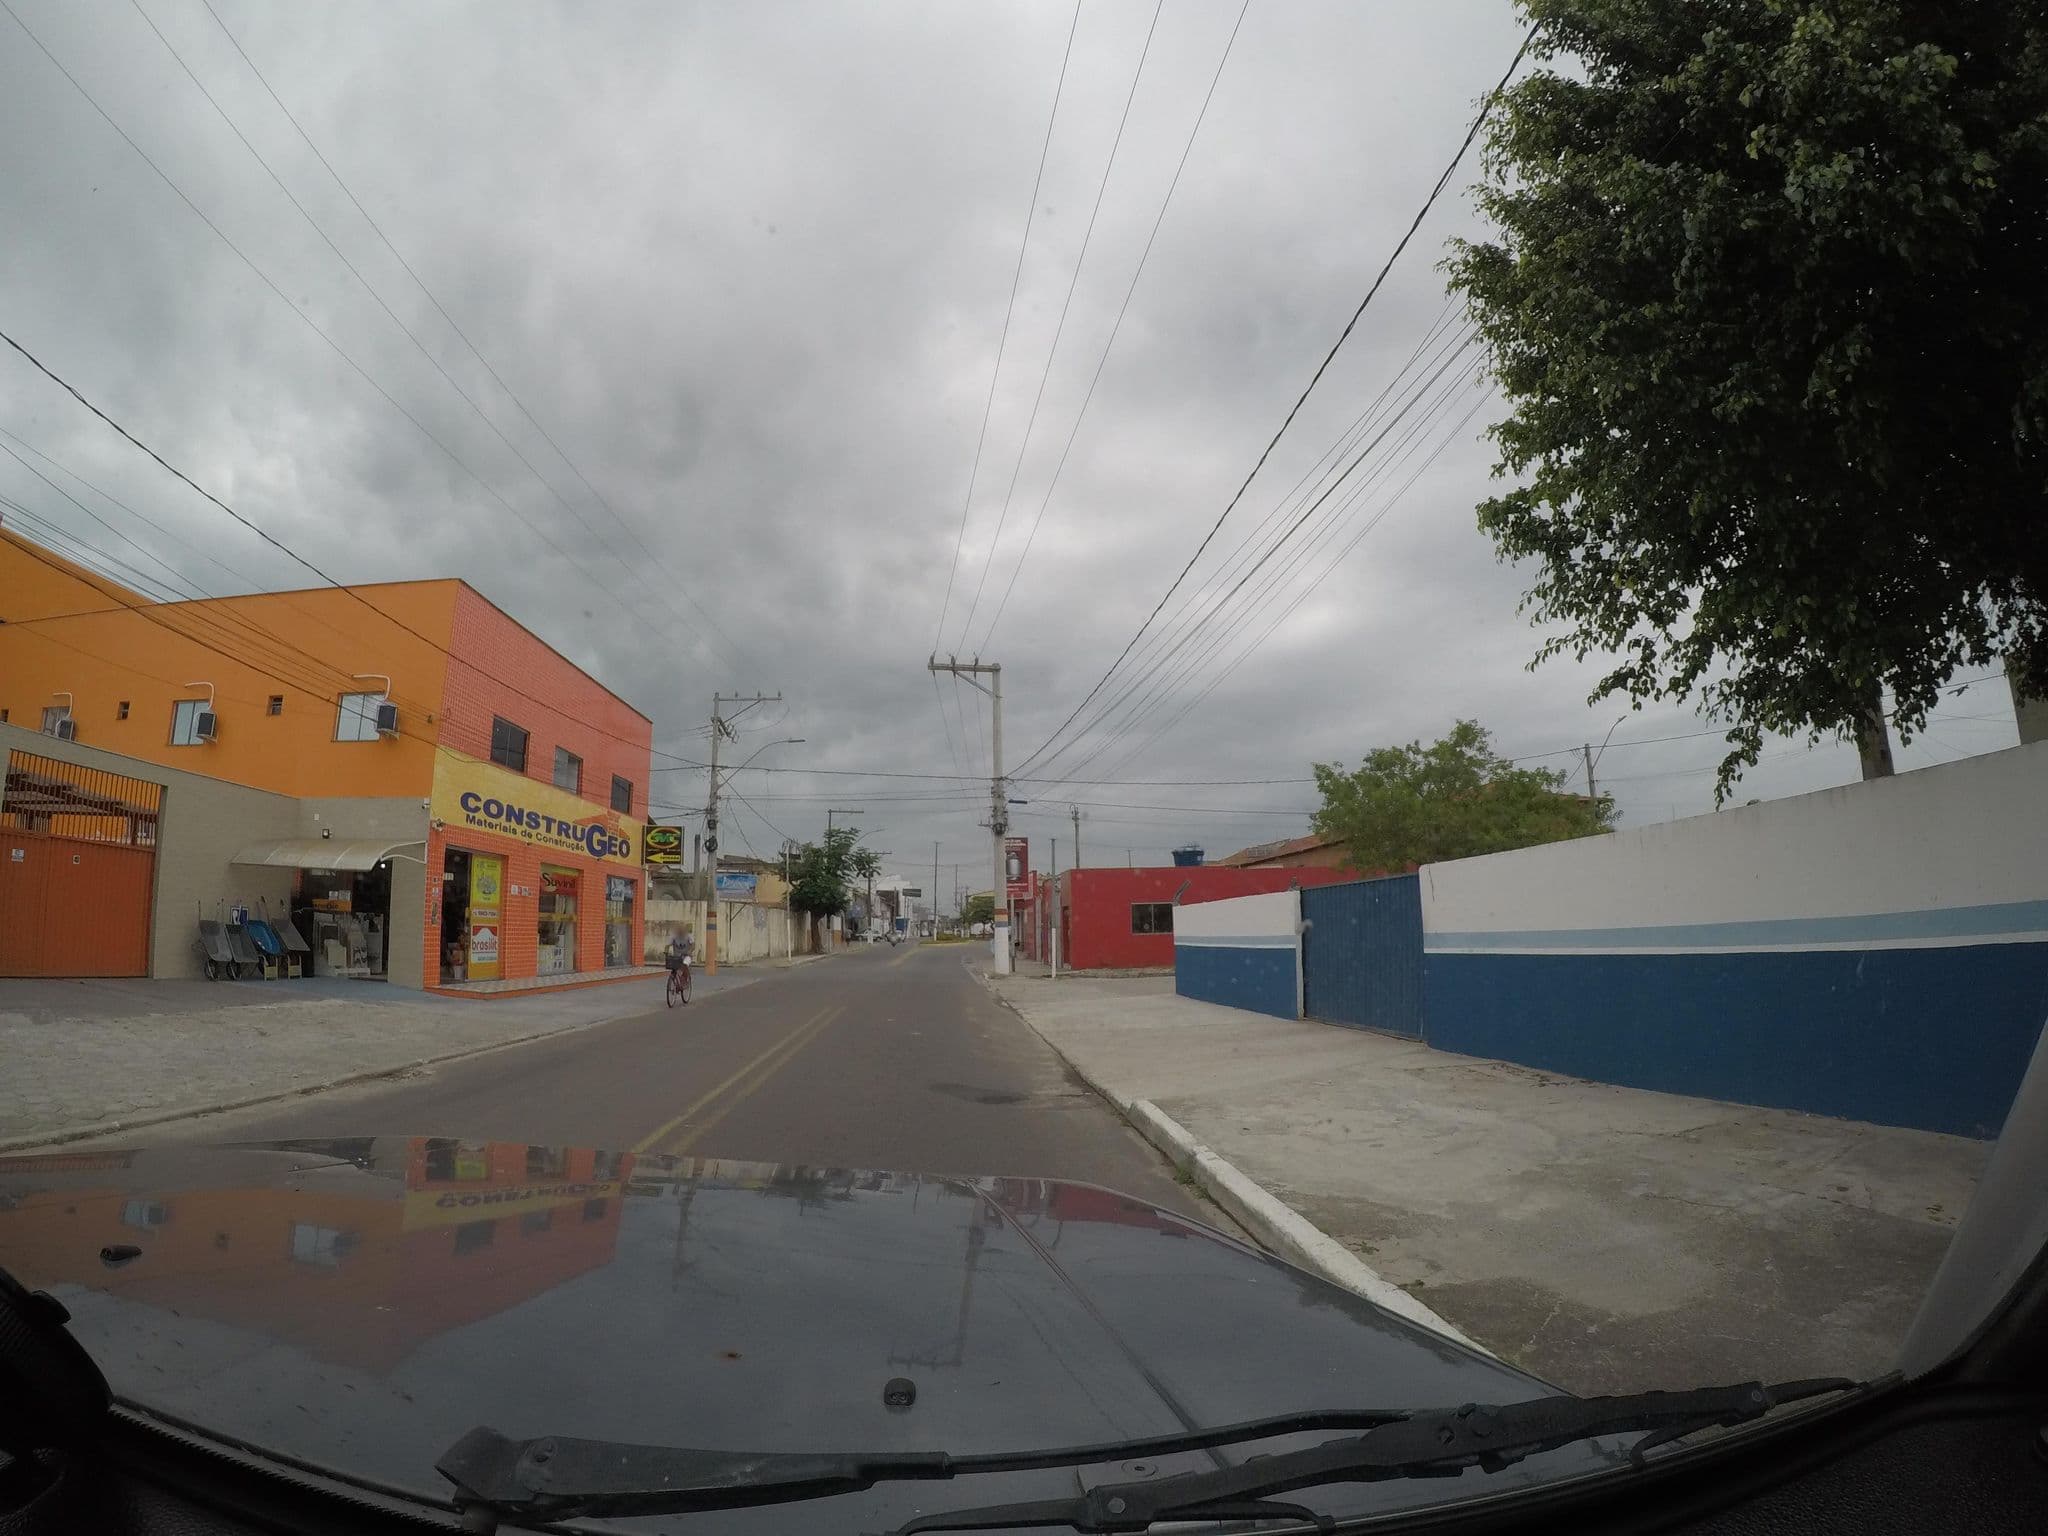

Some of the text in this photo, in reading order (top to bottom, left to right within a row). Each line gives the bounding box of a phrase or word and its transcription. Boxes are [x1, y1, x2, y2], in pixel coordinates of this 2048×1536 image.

[465, 813, 585, 852] Materiais de Construção
[542, 872, 576, 889] Suvinil
[472, 936, 498, 951] brasilit
